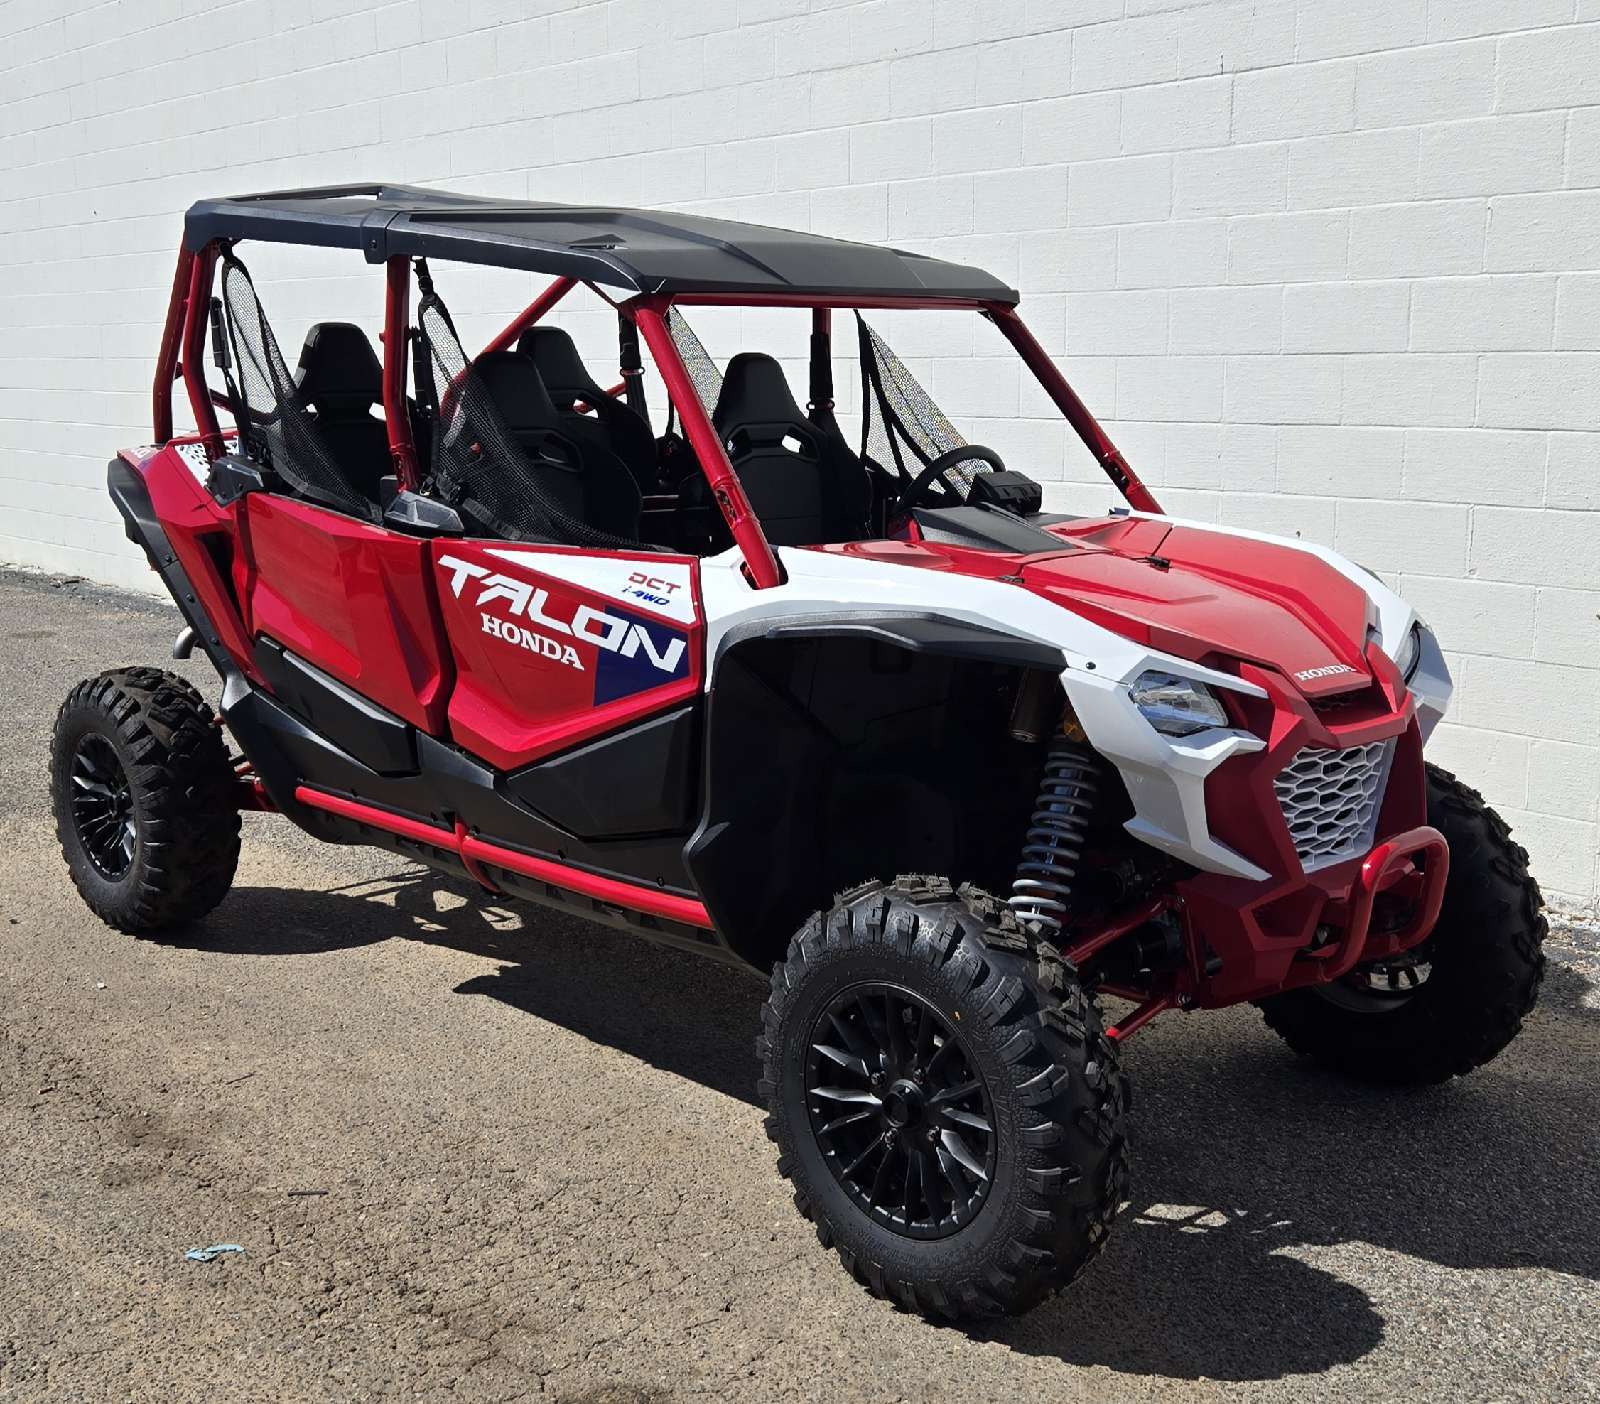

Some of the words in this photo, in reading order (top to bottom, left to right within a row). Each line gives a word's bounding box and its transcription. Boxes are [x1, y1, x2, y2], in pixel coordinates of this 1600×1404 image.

[628, 572, 681, 593] DCT
[438, 555, 687, 673] TALON
[481, 613, 584, 670] HONDA
[1294, 664, 1357, 681] HONDA
